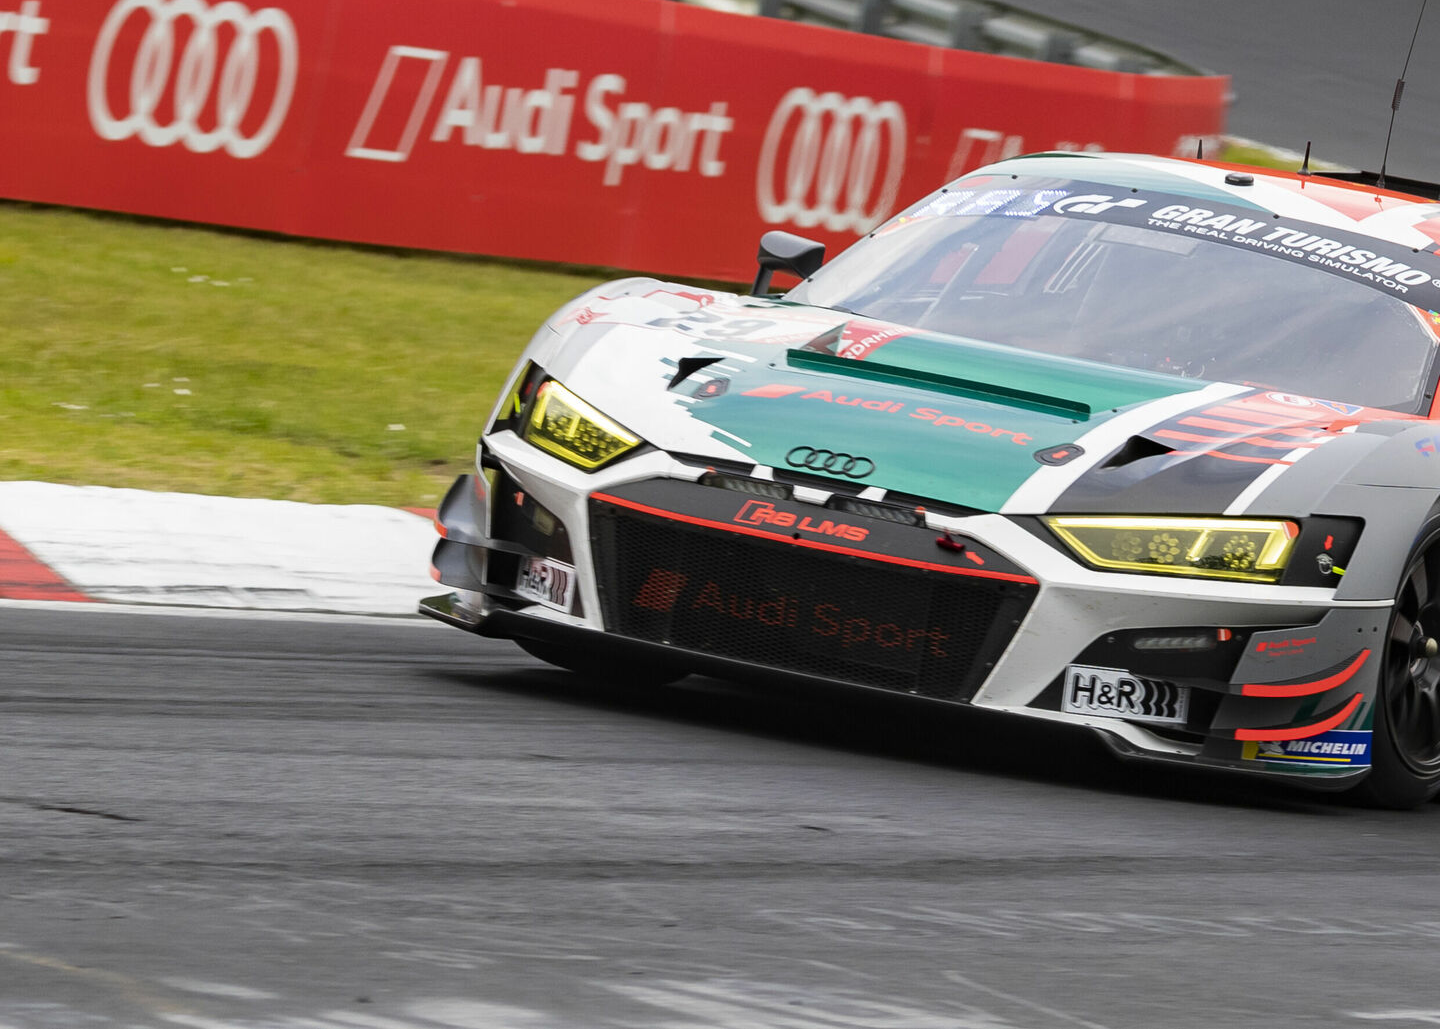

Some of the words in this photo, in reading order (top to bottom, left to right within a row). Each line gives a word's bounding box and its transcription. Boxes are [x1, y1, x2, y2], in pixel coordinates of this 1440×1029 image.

[430, 56, 579, 155] Audi
[575, 73, 734, 187] Sport
[1151, 204, 1268, 235] GRAN
[1147, 218, 1182, 231] THE
[1183, 224, 1228, 240] REAL
[1232, 235, 1304, 259] DRIVING
[1307, 253, 1410, 294] SIMULATOR
[801, 390, 905, 414] Audi
[909, 407, 1033, 446] Sport
[797, 516, 870, 542] LMS
[691, 580, 799, 627] Audi
[811, 602, 951, 658] Sport
[1268, 638, 1290, 649] Audi
[1071, 673, 1138, 712] H&R
[1287, 740, 1367, 755] MICHELIN
